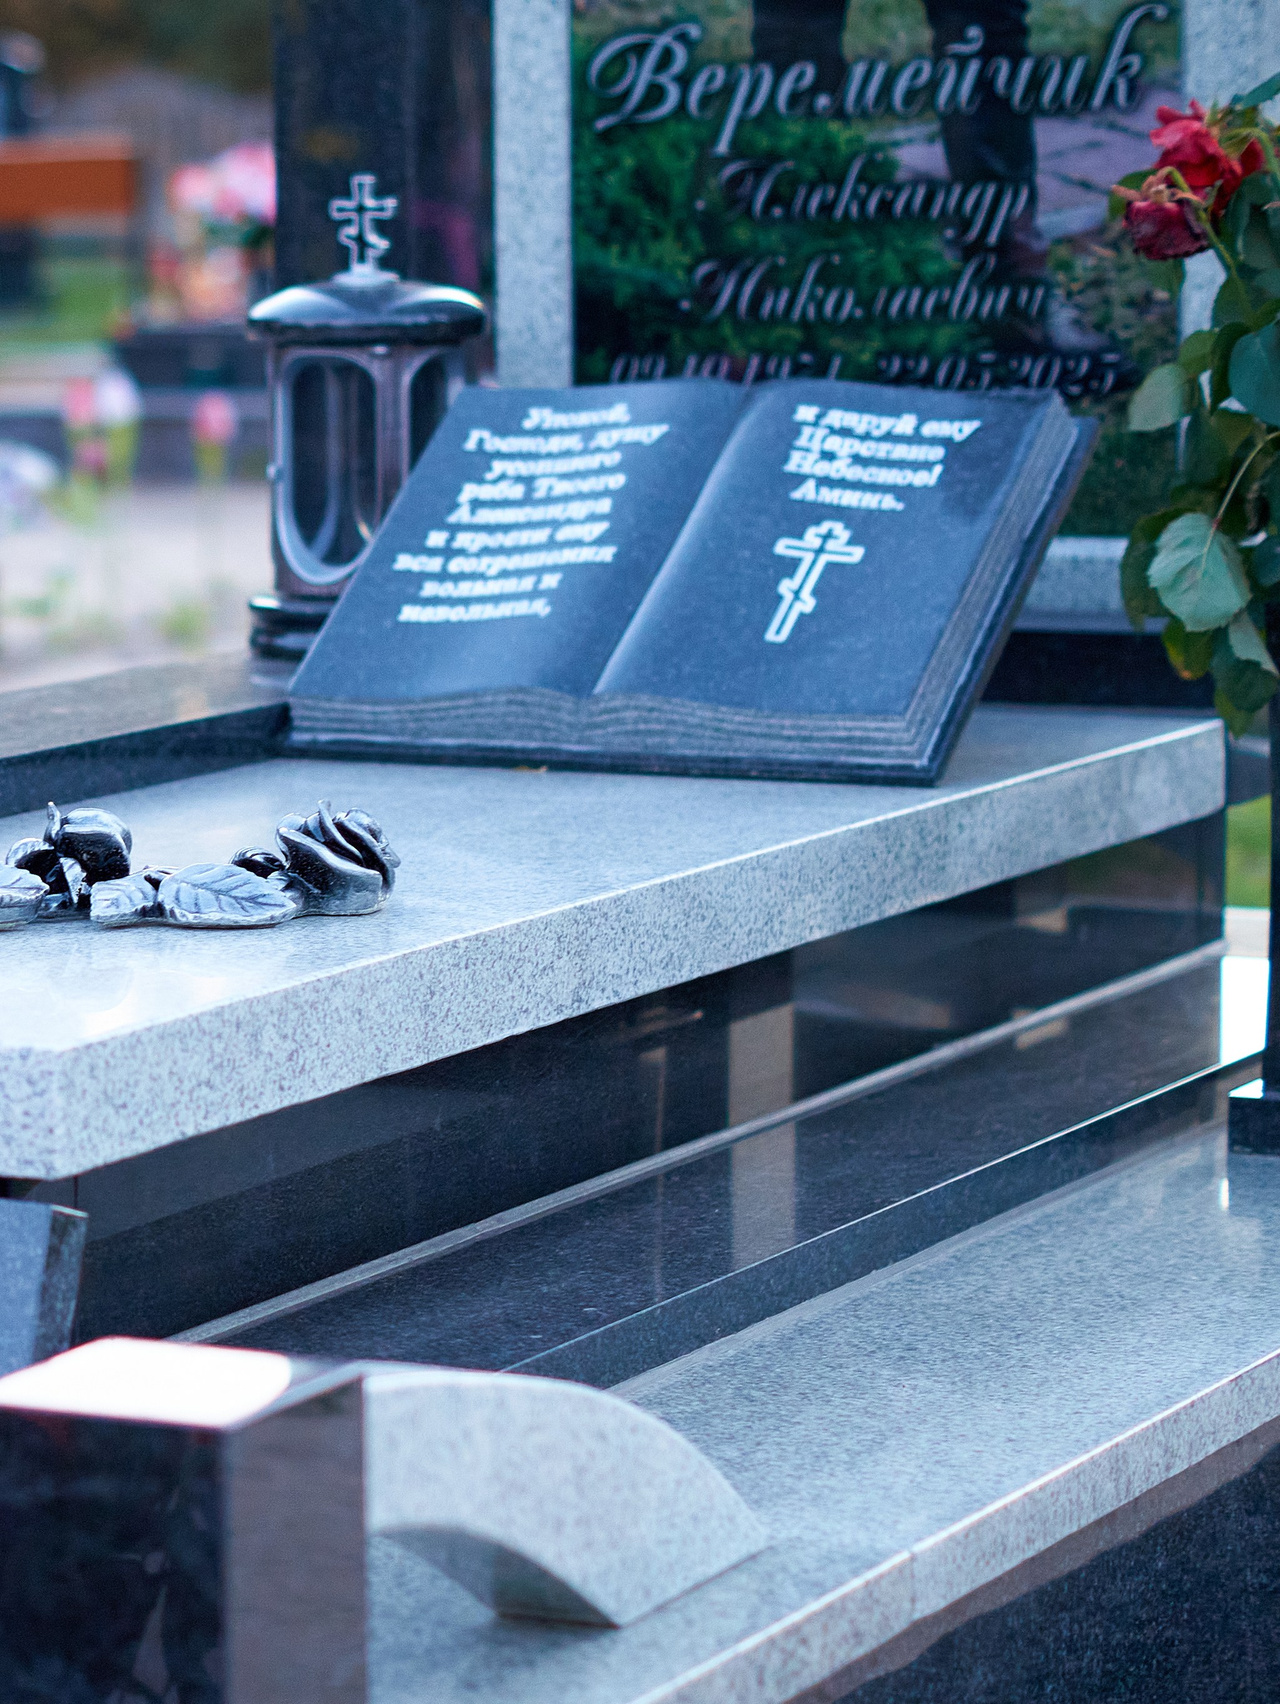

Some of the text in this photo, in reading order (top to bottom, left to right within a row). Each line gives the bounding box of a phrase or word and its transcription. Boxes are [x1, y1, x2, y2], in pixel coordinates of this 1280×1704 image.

[586, 4, 1168, 156] Веремейчик
[694, 152, 1038, 248] Александр
[679, 252, 1052, 322] Николаевич
[820, 409, 918, 437] даруй
[920, 419, 983, 442] ему
[793, 425, 946, 463] Царствие
[531, 473, 627, 499] Твоего
[783, 450, 945, 487] Небесное!
[444, 499, 613, 524] Александра
[789, 478, 905, 511] Аминь.
[451, 527, 553, 554] прости
[554, 519, 611, 543] ему
[392, 553, 445, 573] вся
